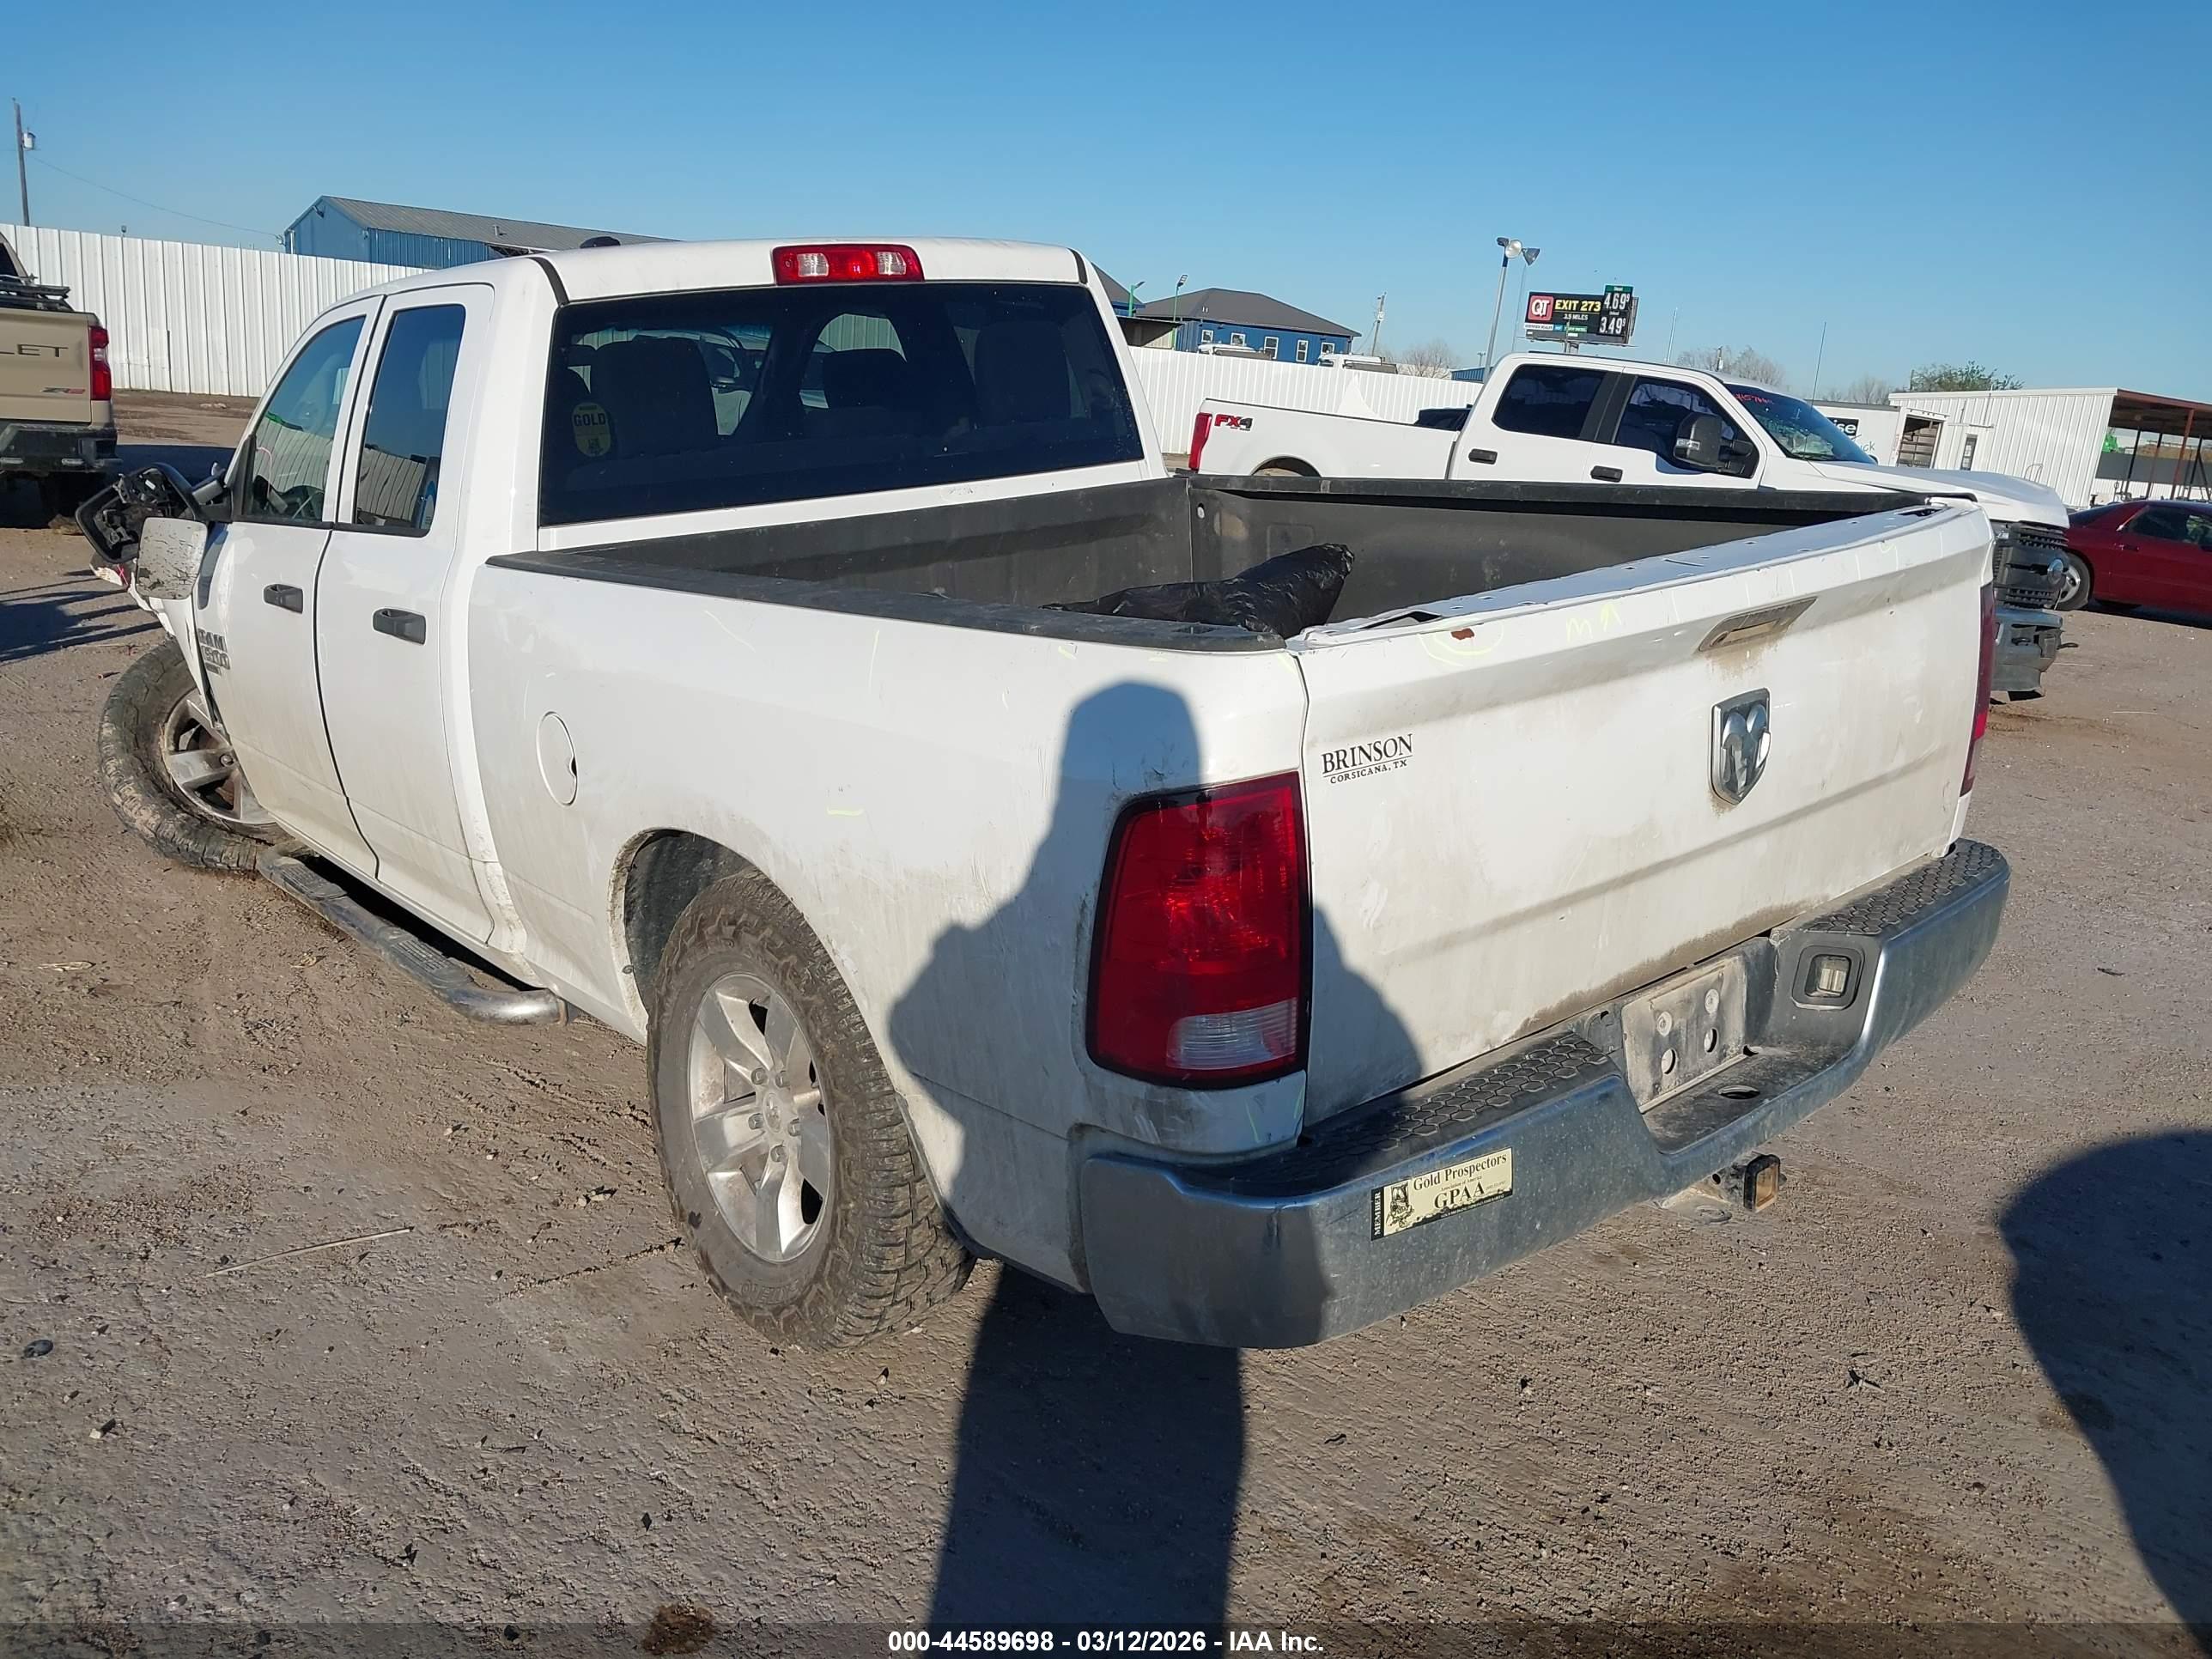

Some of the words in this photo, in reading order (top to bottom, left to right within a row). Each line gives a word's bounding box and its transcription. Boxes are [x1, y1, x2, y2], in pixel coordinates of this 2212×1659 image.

[1531, 299, 1550, 317] QT
[1554, 300, 1579, 310] EXIT
[1580, 301, 1601, 312] 273
[574, 413, 605, 427] GOLD
[1214, 413, 1253, 429] FX4
[1322, 733, 1413, 774] BRINSON
[1330, 764, 1391, 784] CORSICANA,
[1393, 759, 1407, 769] TX
[1413, 1174, 1440, 1191] Gold
[1445, 1154, 1507, 1182] Prospectors
[1435, 1181, 1485, 1209] GPAA
